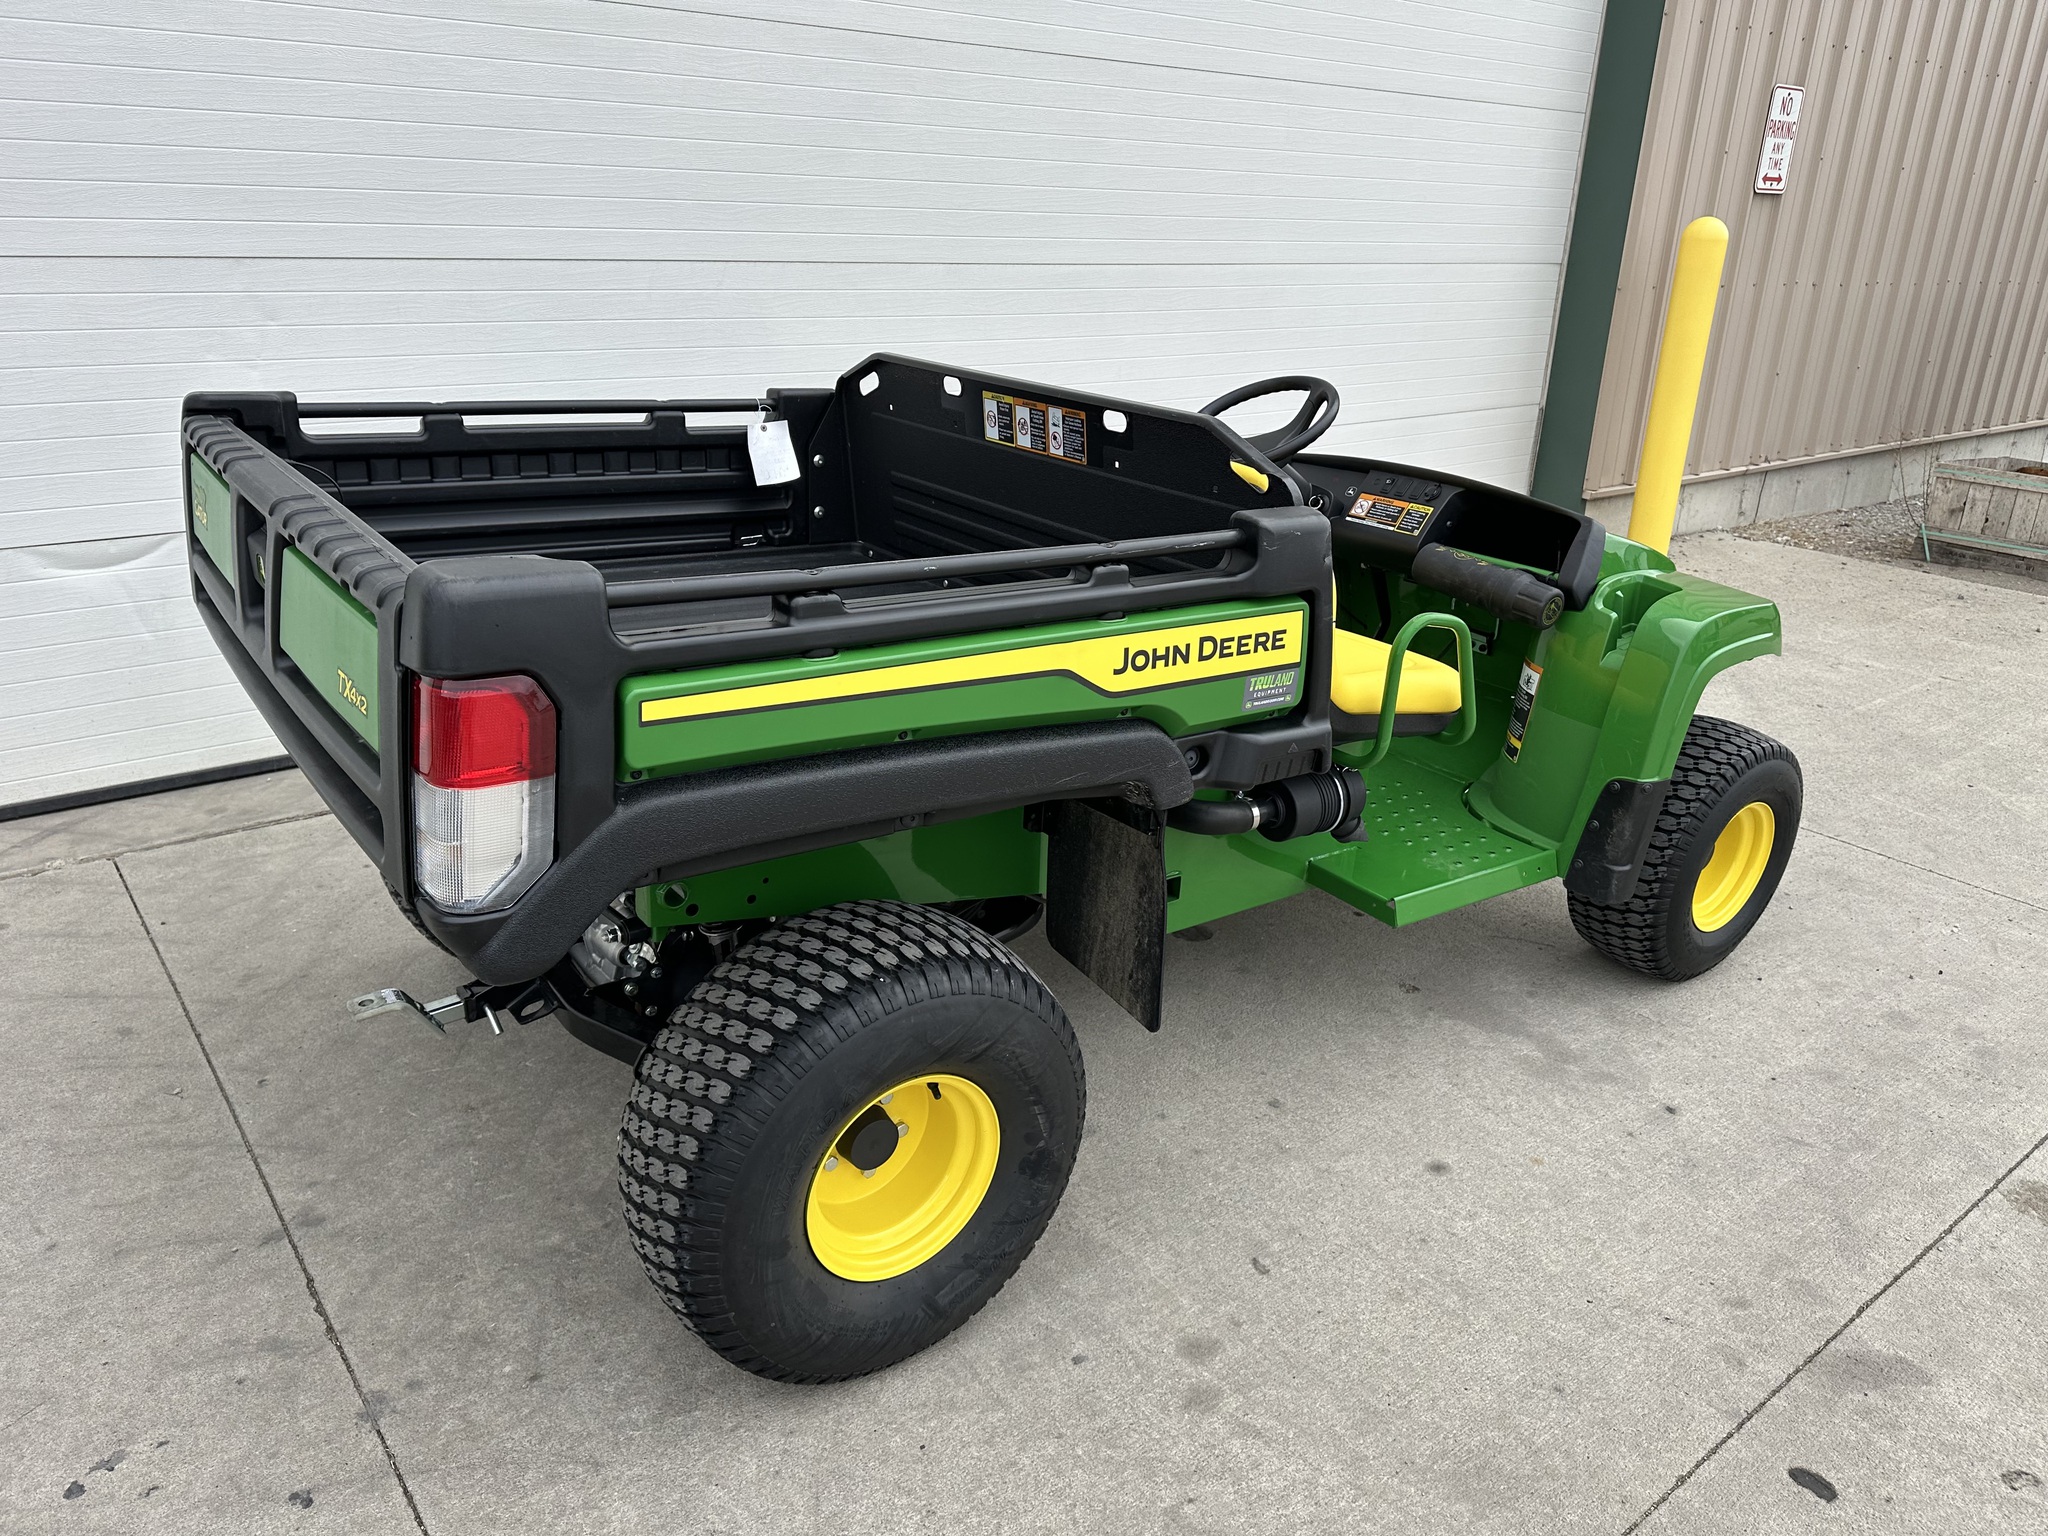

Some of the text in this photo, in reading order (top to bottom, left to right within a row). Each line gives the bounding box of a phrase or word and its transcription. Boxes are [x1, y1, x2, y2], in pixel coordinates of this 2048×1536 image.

[1779, 96, 1793, 116] NO
[1767, 119, 1796, 140] PARKING
[1771, 141, 1785, 155] ANY
[1768, 157, 1783, 170] TIME
[1113, 629, 1287, 675] JOHN DEERE
[1249, 671, 1295, 692] TRULAND
[1253, 687, 1287, 698] EQUIPMENT
